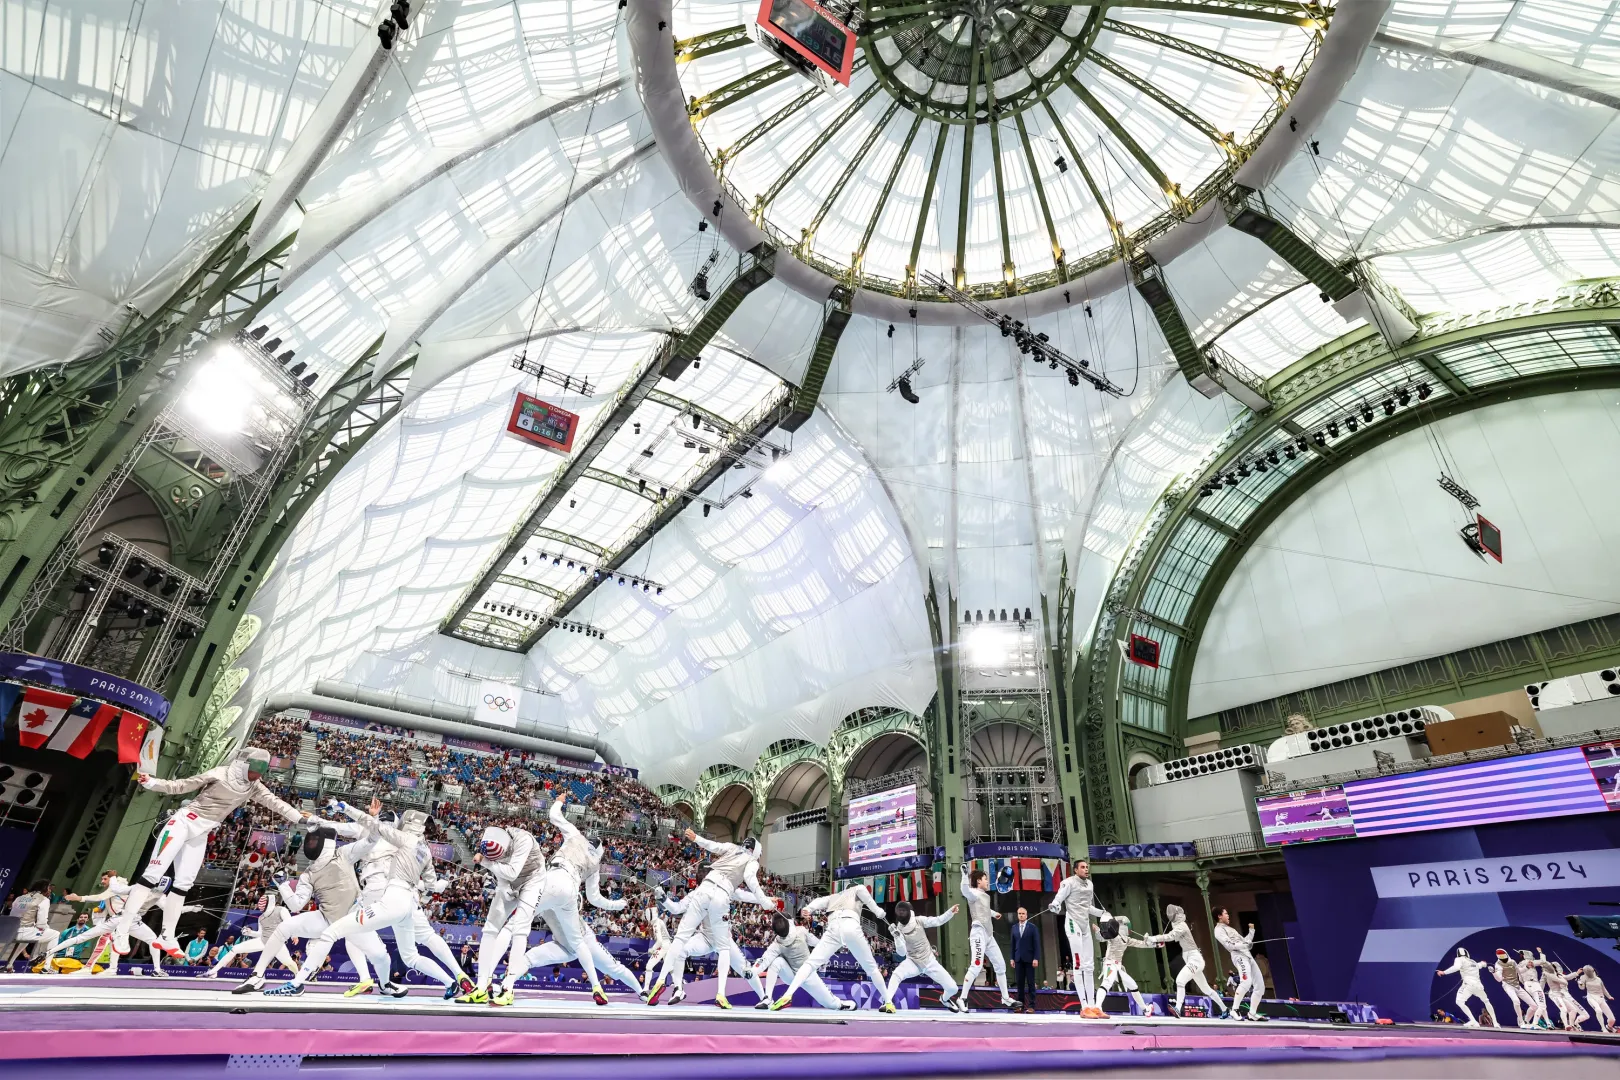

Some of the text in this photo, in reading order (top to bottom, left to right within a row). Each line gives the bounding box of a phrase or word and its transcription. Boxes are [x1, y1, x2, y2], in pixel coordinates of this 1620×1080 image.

[821, 11, 847, 34] OMEGA
[825, 46, 841, 64] 15
[553, 407, 572, 418] OMEGA
[522, 418, 529, 426] 6
[533, 425, 551, 436] 0:16
[556, 431, 563, 440] 8
[129, 690, 154, 708] 2024
[340, 716, 359, 726] 2024
[468, 740, 485, 749] 2024
[579, 761, 594, 769] 2024
[1500, 860, 1588, 883] 2024
[1237, 956, 1247, 975] JAPAN
